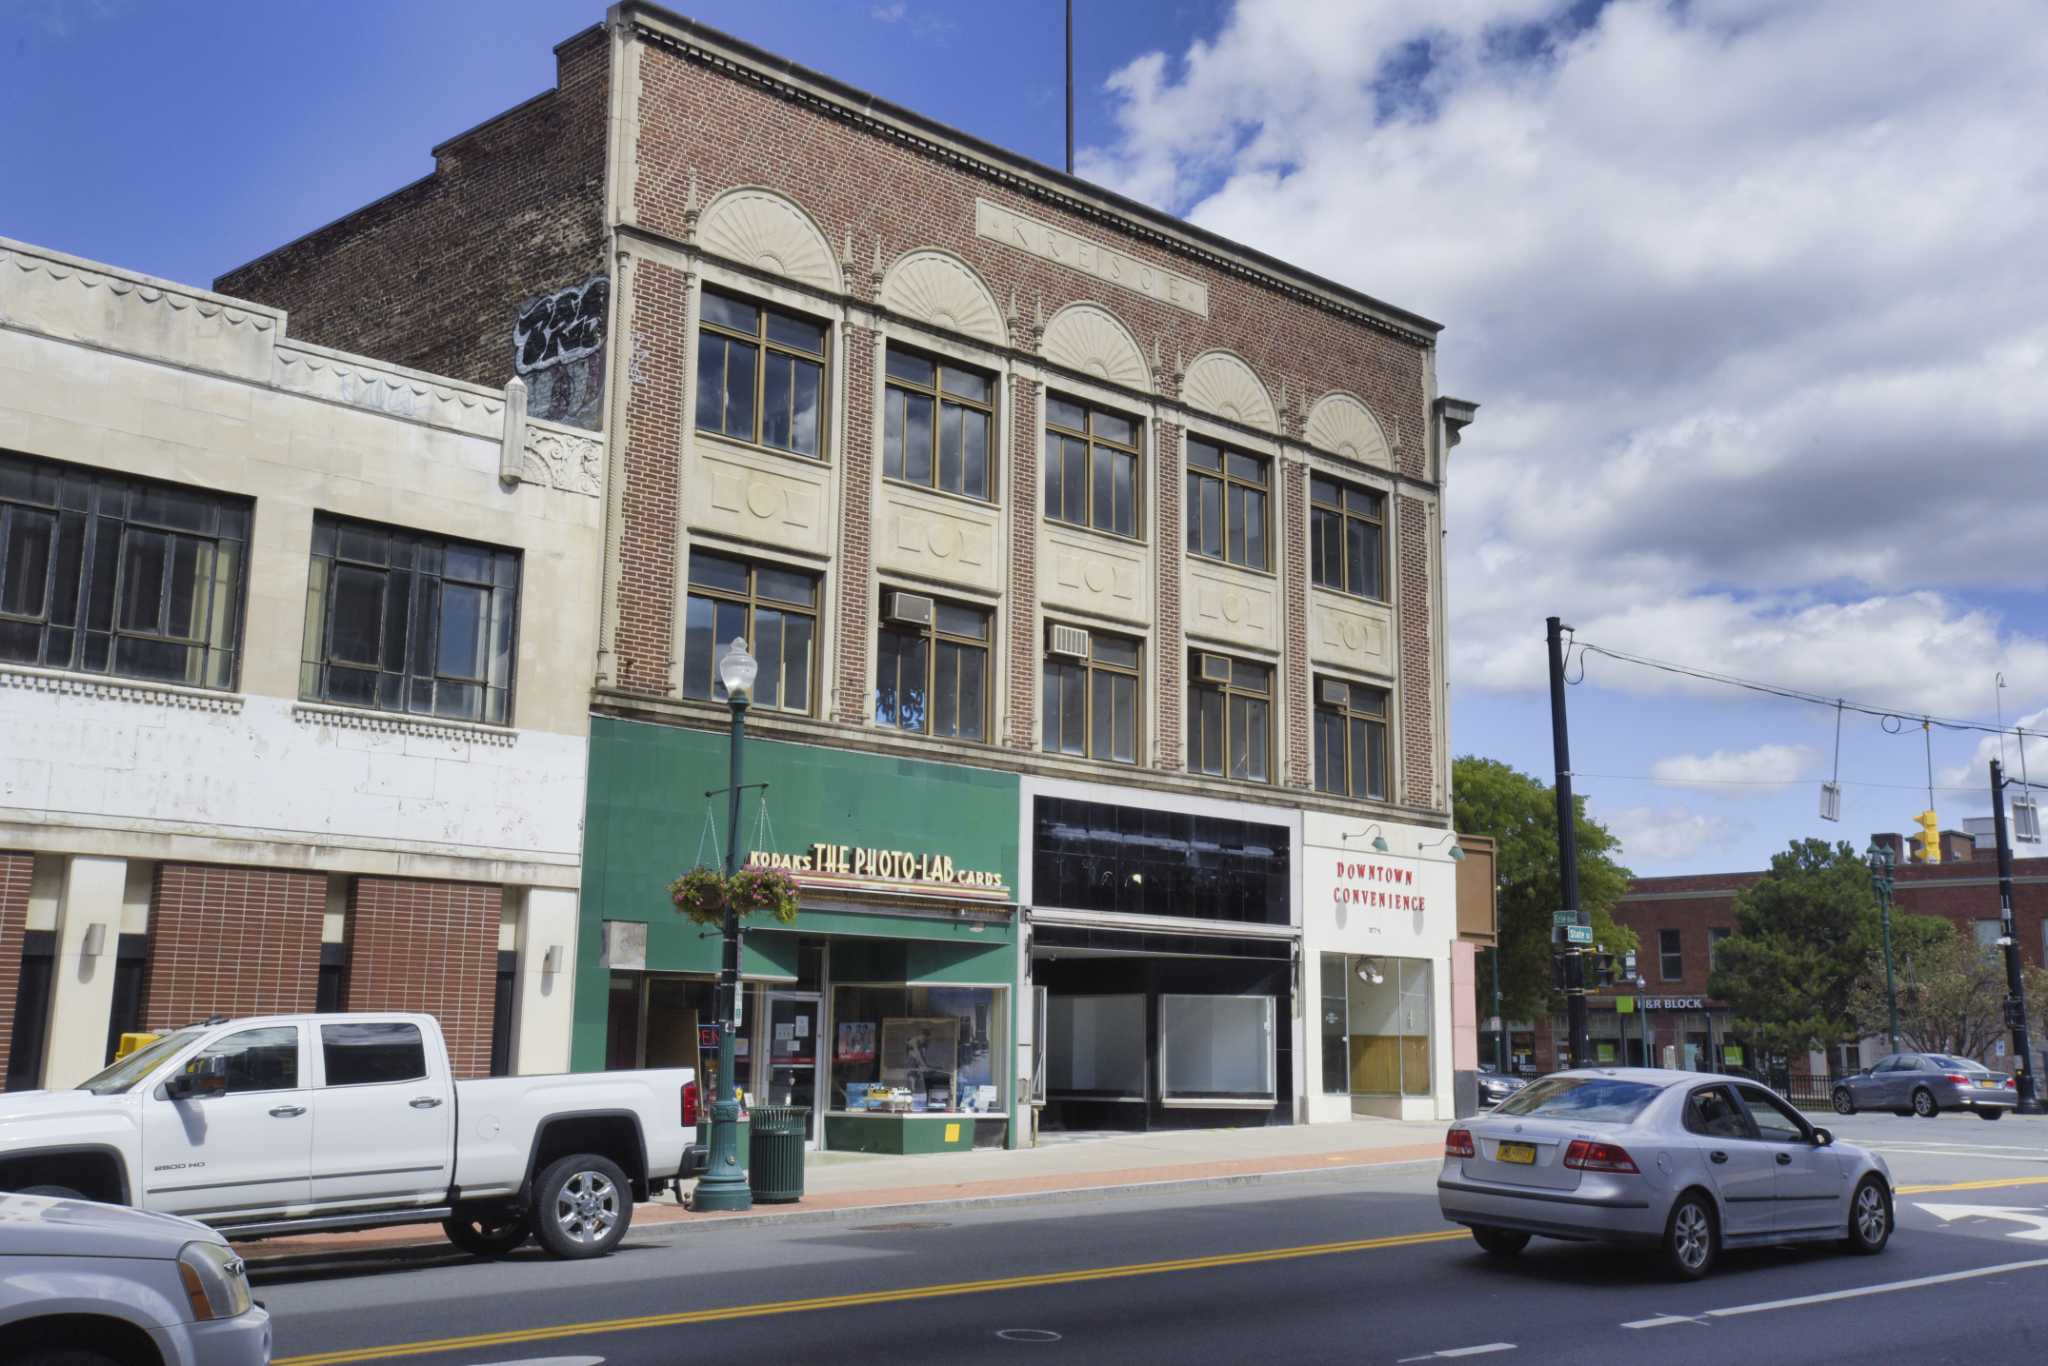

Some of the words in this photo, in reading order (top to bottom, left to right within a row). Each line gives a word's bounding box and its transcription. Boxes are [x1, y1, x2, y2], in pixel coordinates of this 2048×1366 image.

[751, 849, 812, 872] KODAKS
[814, 842, 851, 874] THE
[855, 847, 953, 883] PHOTO-LAB
[958, 869, 1002, 887] CARDS
[1337, 862, 1412, 885] DOWNTOWN
[1333, 887, 1425, 911] CONVENIENCE
[1664, 998, 1703, 1010] BLOCK
